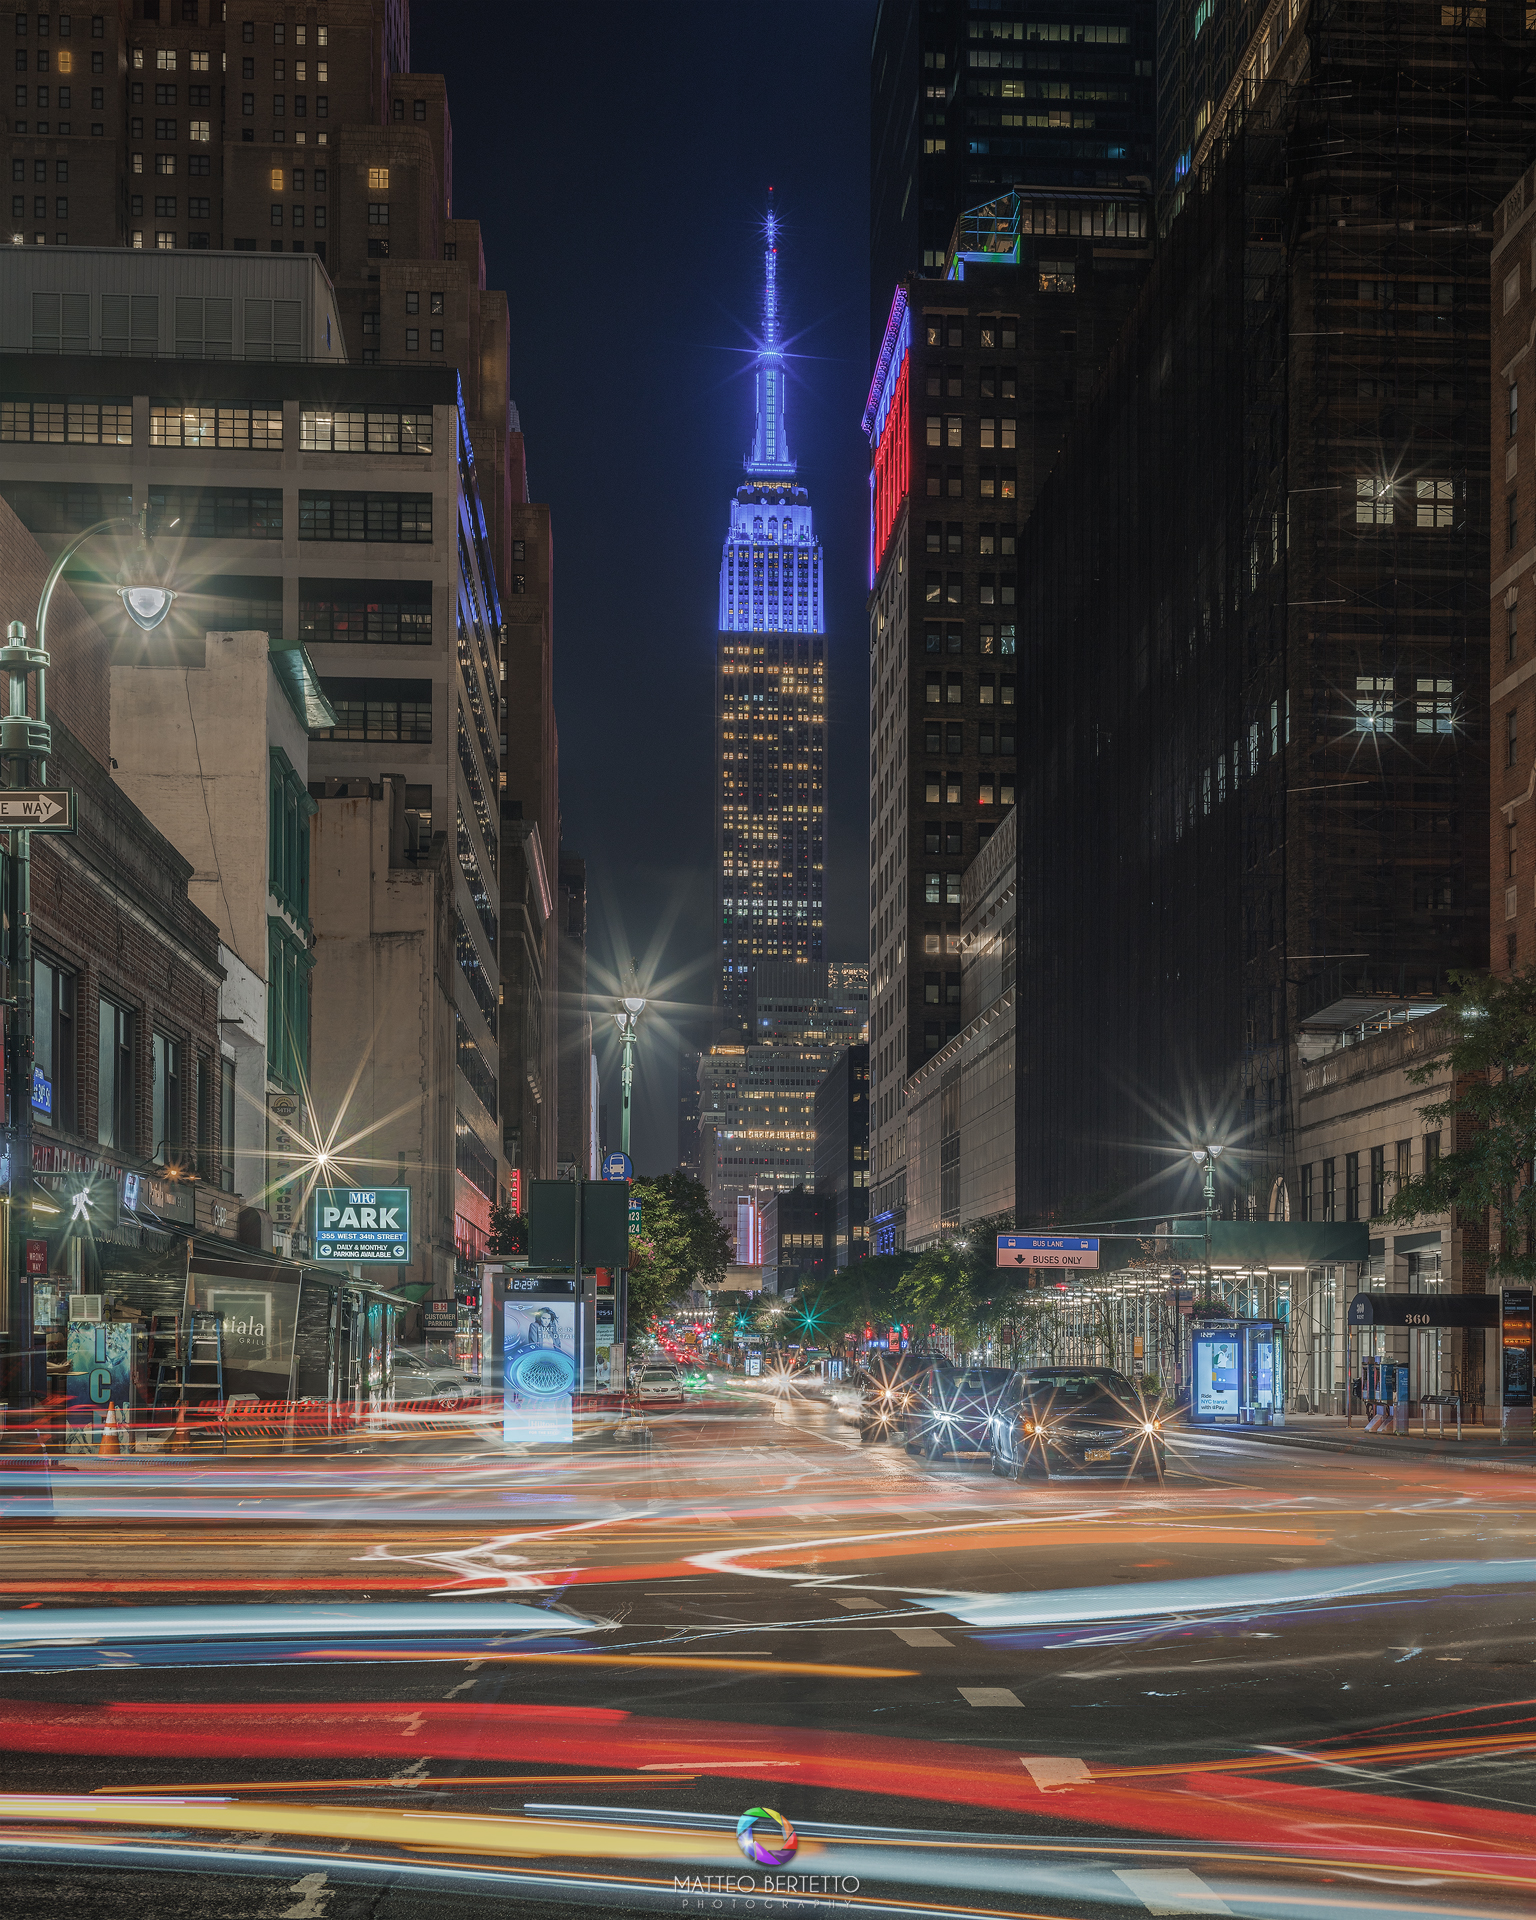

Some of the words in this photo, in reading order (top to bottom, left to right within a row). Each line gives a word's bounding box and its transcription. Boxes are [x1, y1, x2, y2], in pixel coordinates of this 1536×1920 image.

[23, 803, 52, 814] WAY
[351, 1193, 375, 1203] MPG
[276, 1188, 292, 1221] MORE
[323, 1206, 400, 1229] PARK
[29, 1252, 44, 1261] WRONG
[1032, 1255, 1059, 1264] BUSES
[1062, 1256, 1083, 1265] ONLY
[32, 1262, 41, 1271] WAY
[1405, 1313, 1431, 1325] 360
[239, 1337, 265, 1346] GRILL
[531, 1421, 555, 1429] Hilton
